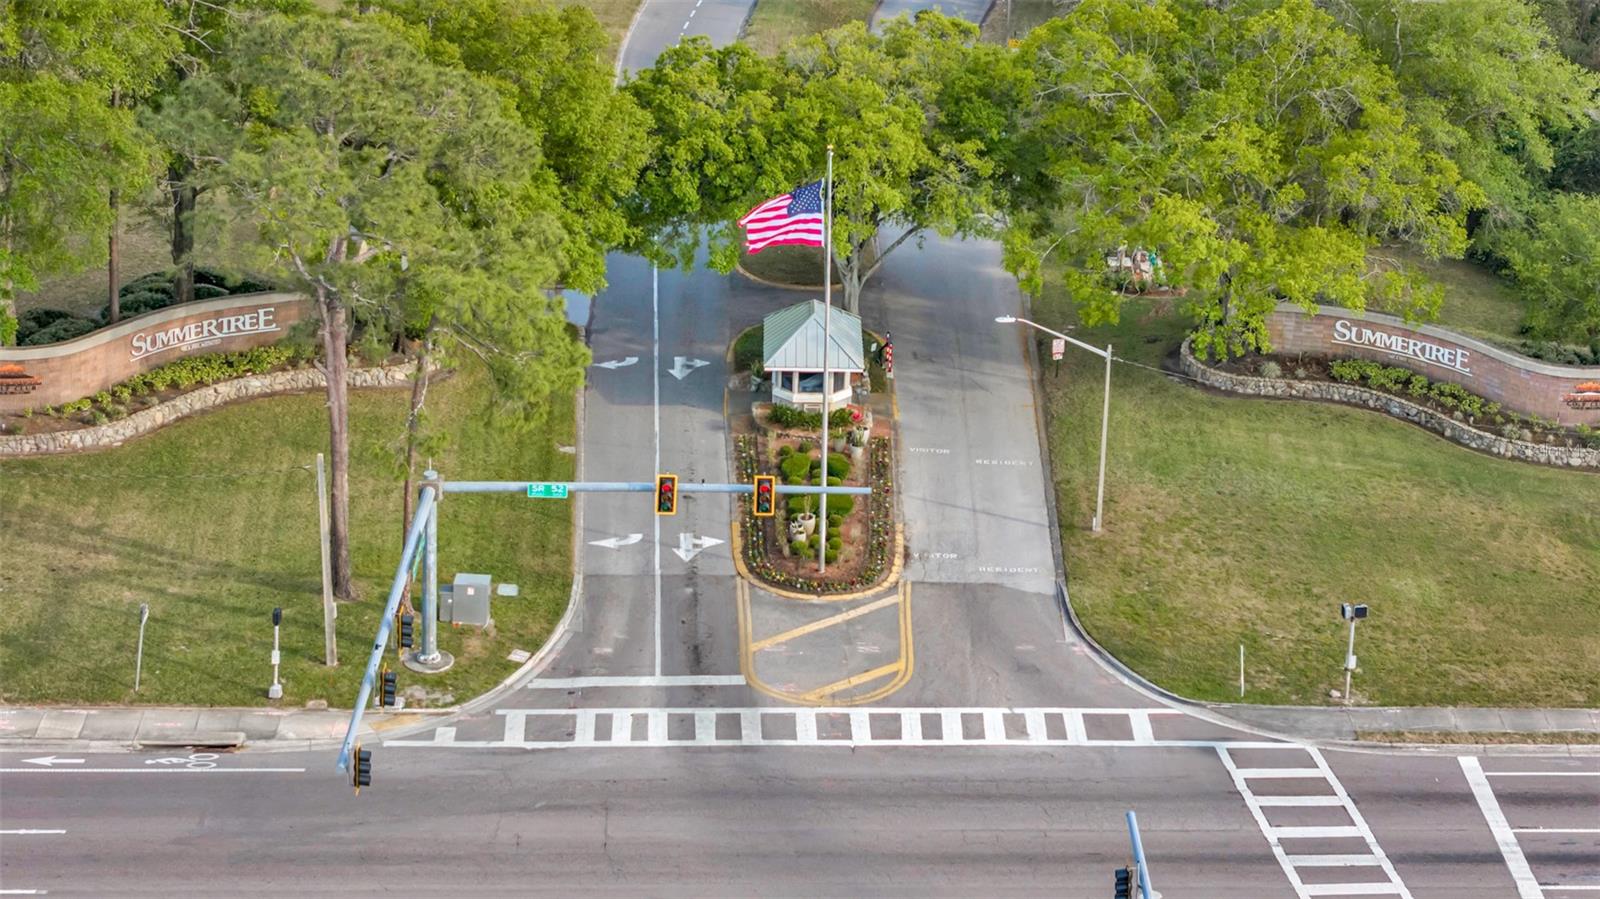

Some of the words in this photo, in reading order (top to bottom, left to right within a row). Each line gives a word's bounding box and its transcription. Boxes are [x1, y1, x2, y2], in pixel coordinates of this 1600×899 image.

[131, 307, 276, 356] SUMMERTREE
[1333, 319, 1471, 372] SUMMERTREE
[909, 447, 950, 455] VISITOR
[531, 484, 545, 493] SR
[551, 484, 564, 493] 52
